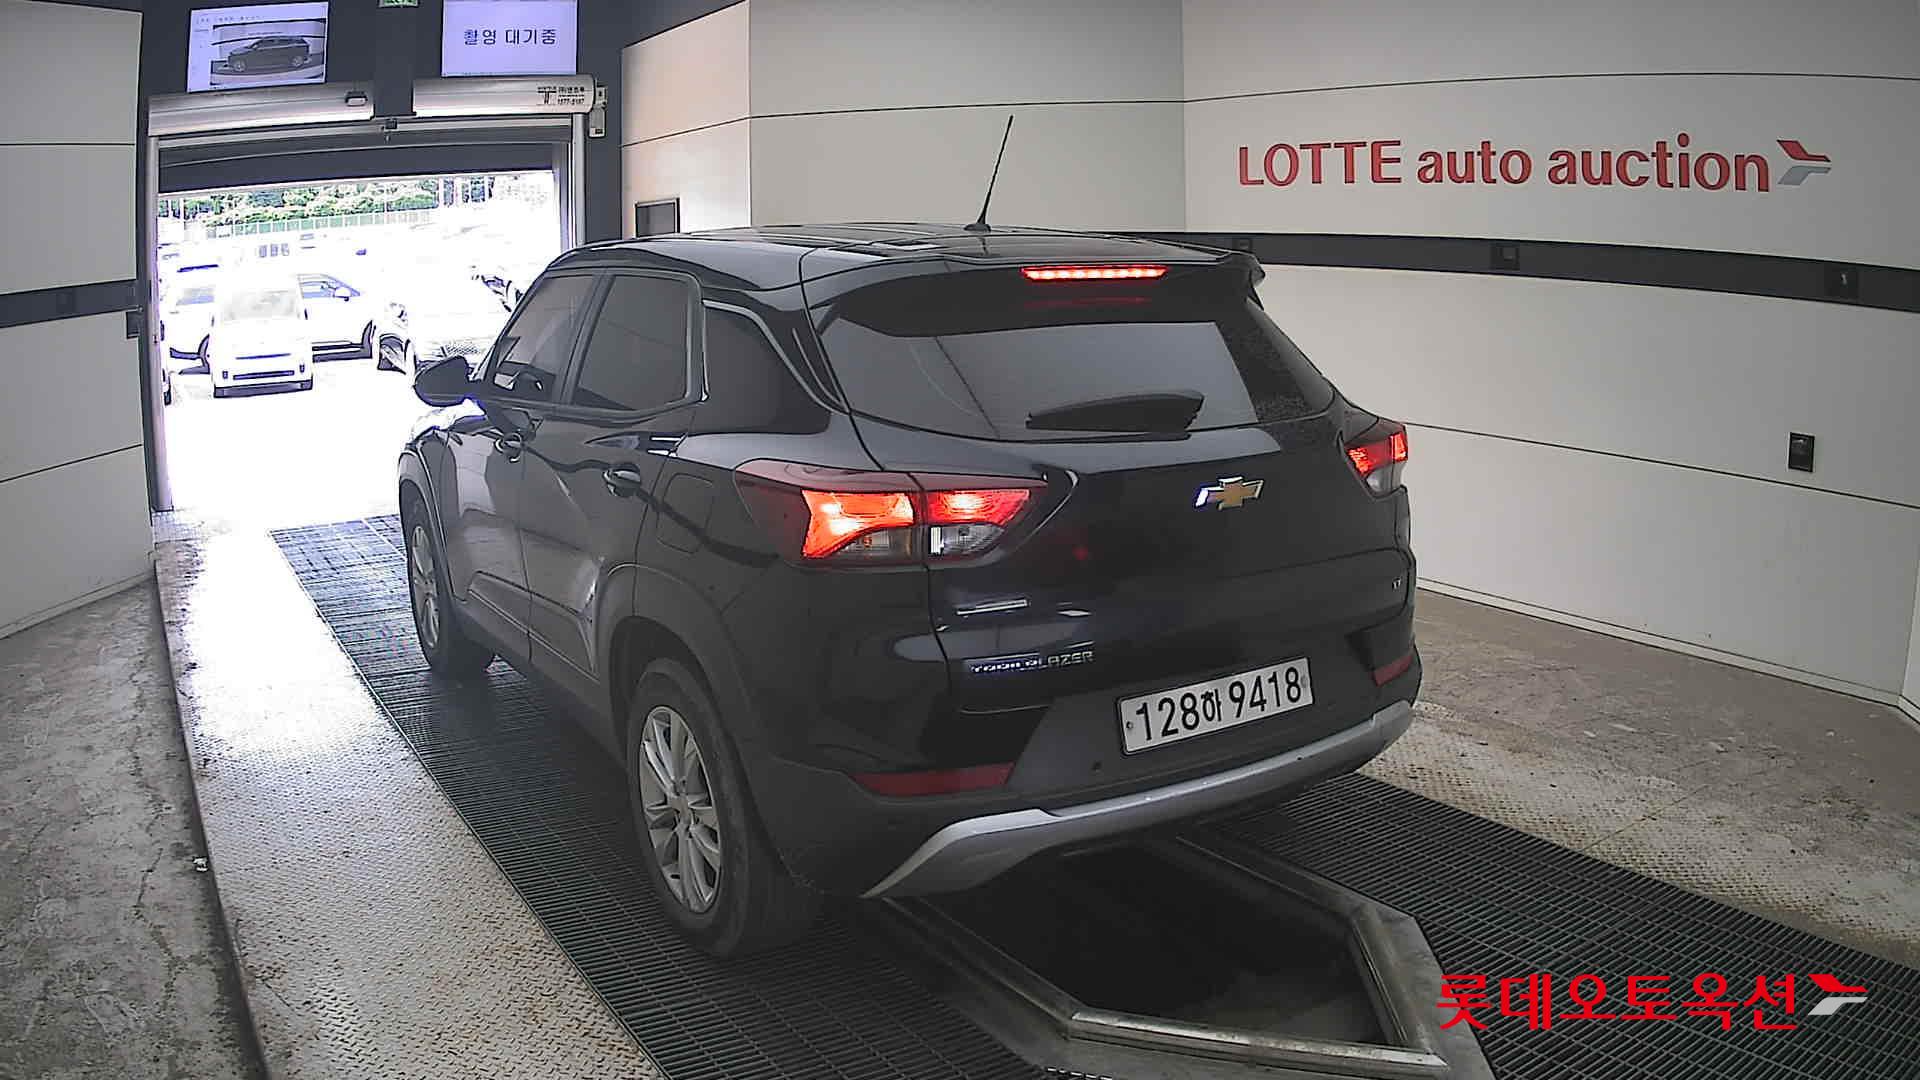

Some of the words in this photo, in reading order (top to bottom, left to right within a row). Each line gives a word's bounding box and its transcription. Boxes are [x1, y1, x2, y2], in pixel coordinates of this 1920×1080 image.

[464, 29, 496, 45] 촬영
[504, 28, 556, 45] 대기중
[1239, 140, 1401, 187] LOTTE
[1417, 140, 1532, 184] auto
[1547, 133, 1770, 192] auction
[1135, 688, 1222, 741] 128하
[1228, 667, 1301, 718] 9418
